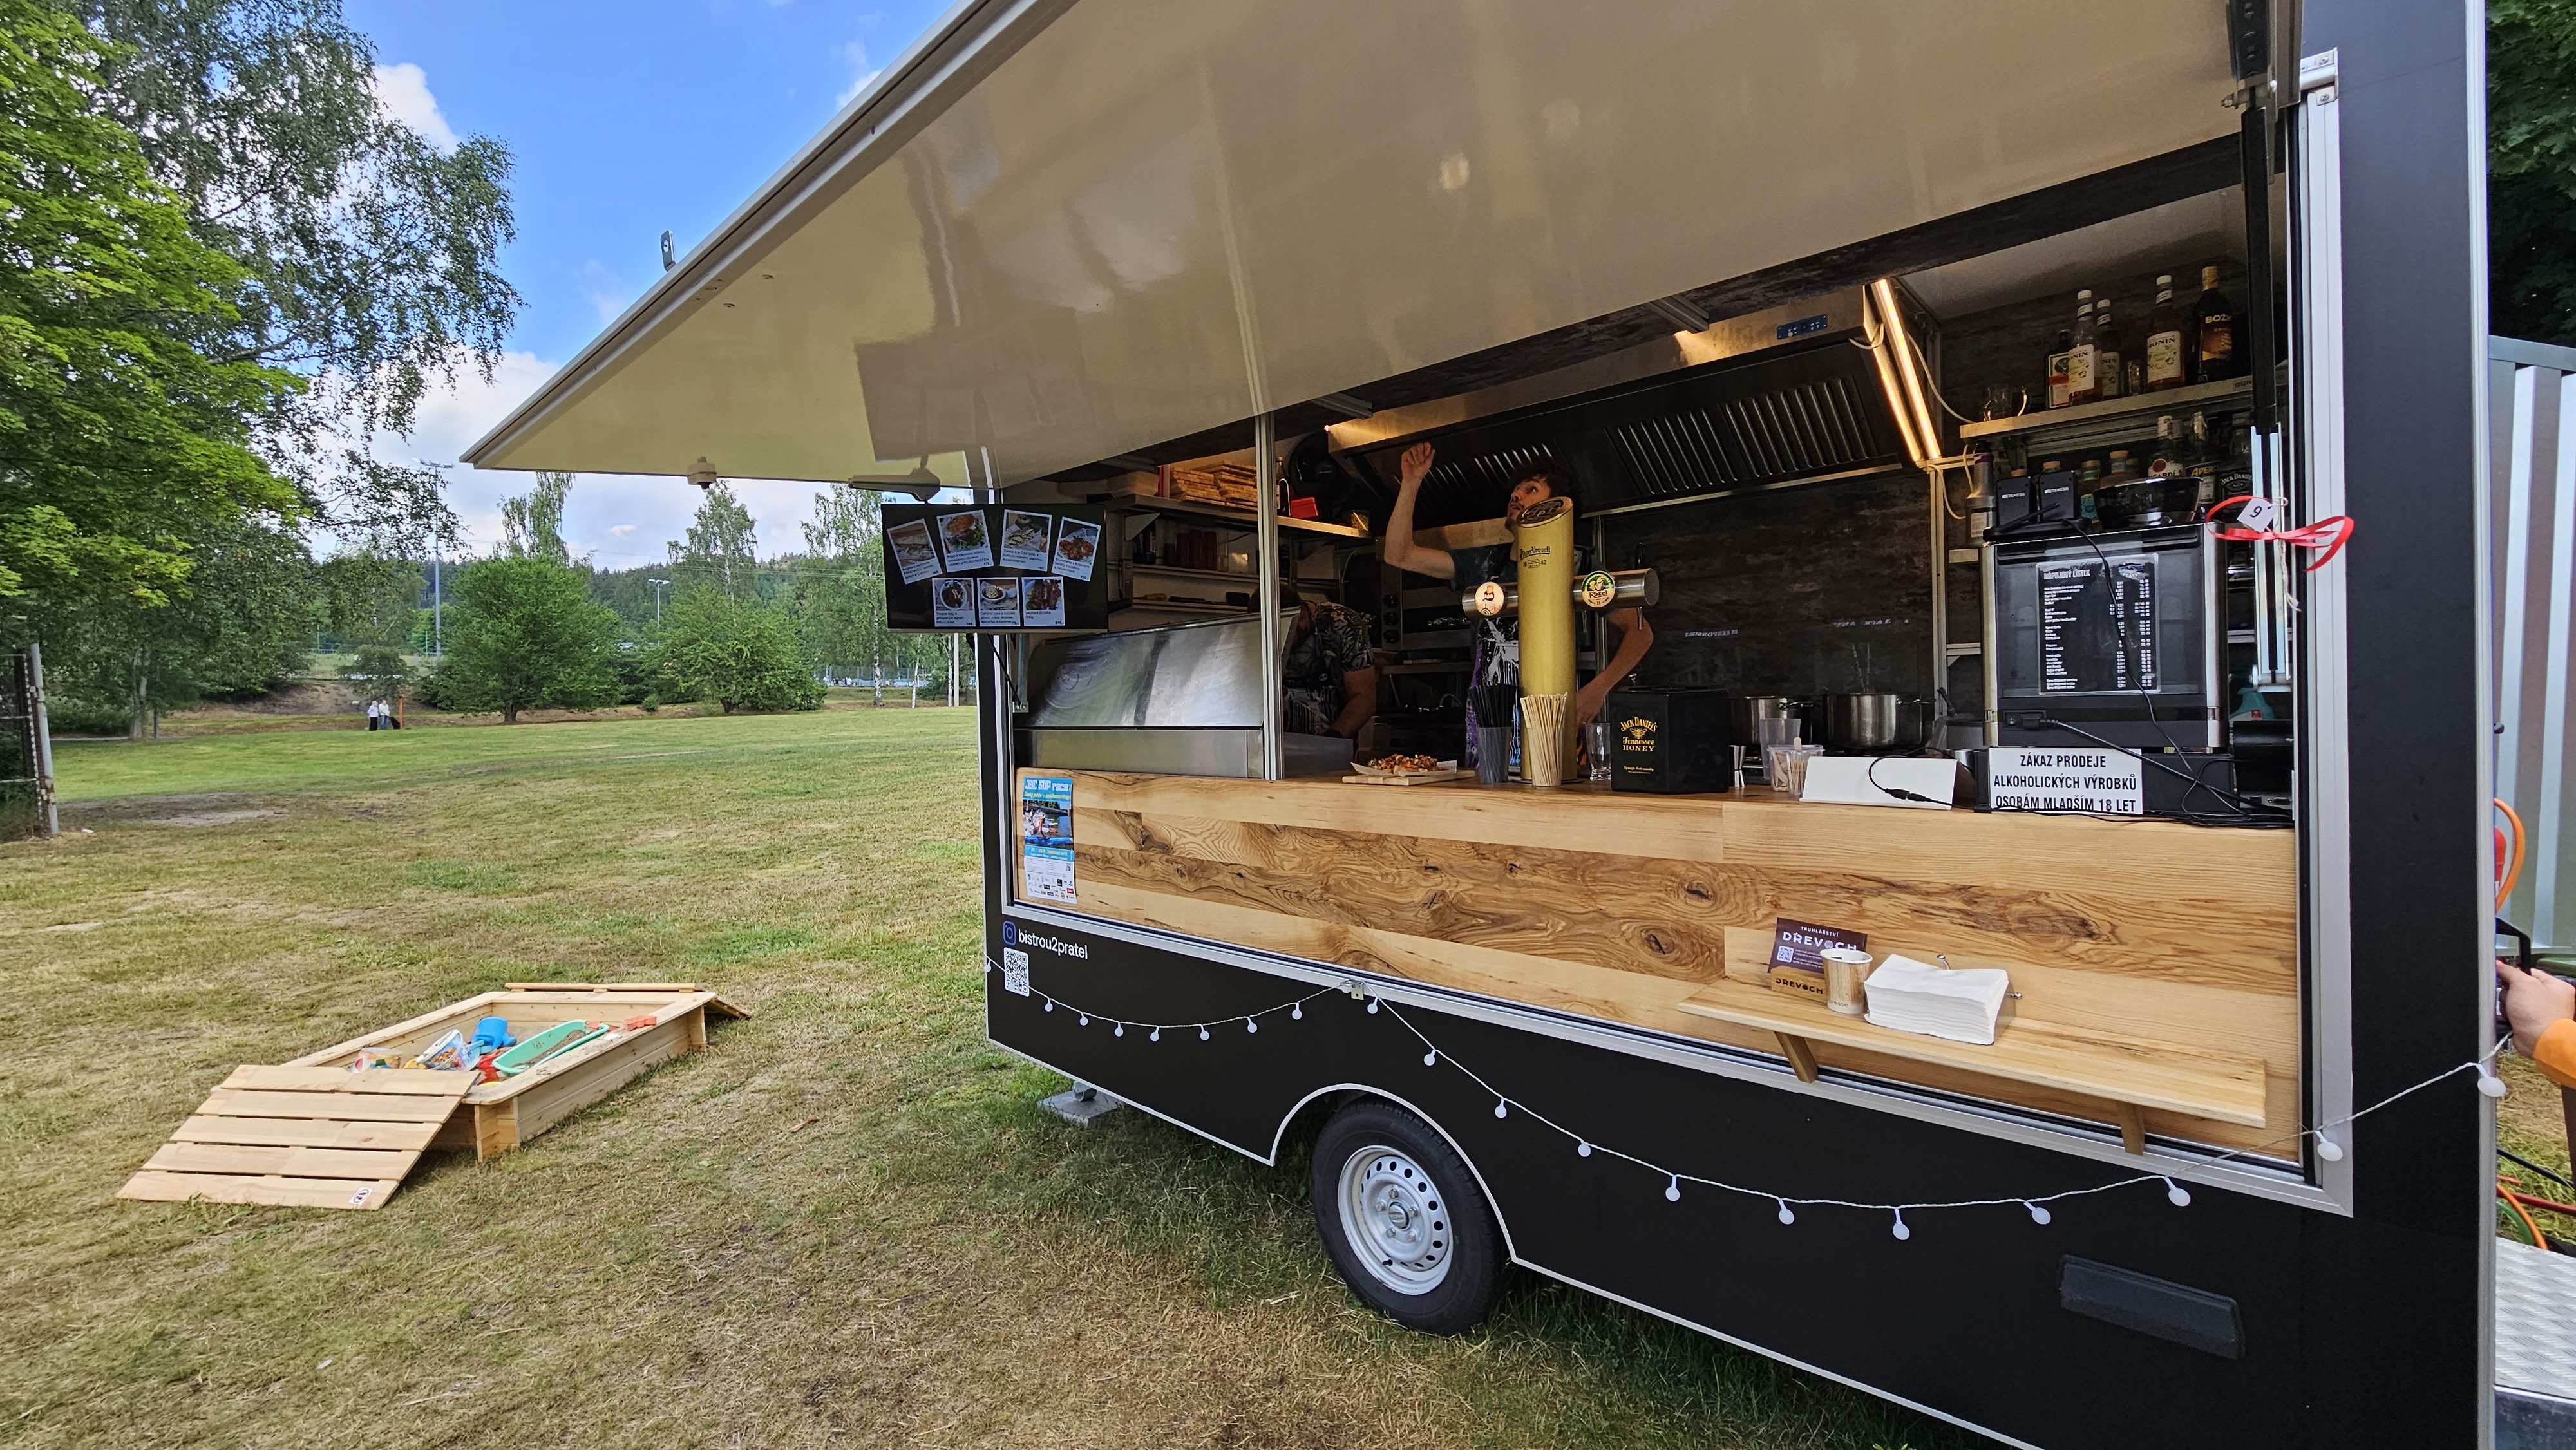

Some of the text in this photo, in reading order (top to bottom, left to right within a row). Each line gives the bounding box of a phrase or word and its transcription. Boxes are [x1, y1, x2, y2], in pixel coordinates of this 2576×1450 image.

[2205, 313, 2232, 324] BOŽK
[2191, 466, 2219, 477] APERO
[2249, 505, 2262, 518] 9
[1620, 716, 1658, 733] JACK DANIEL'S
[1622, 736, 1654, 745] Tennessee
[2020, 752, 2106, 768] ZÁKAZ PRODEJE
[1038, 780, 1051, 790] SUP
[1052, 783, 1068, 791] race
[1994, 773, 2137, 790] ALKOHOLICKÝCH VÝROBKŮ
[1996, 793, 2136, 812] OSOBÁM MLADŠÍM 18 LET
[1801, 926, 1839, 937] TRUHLÁŘSTVÍ
[1018, 928, 1088, 959] bistrou2pratel
